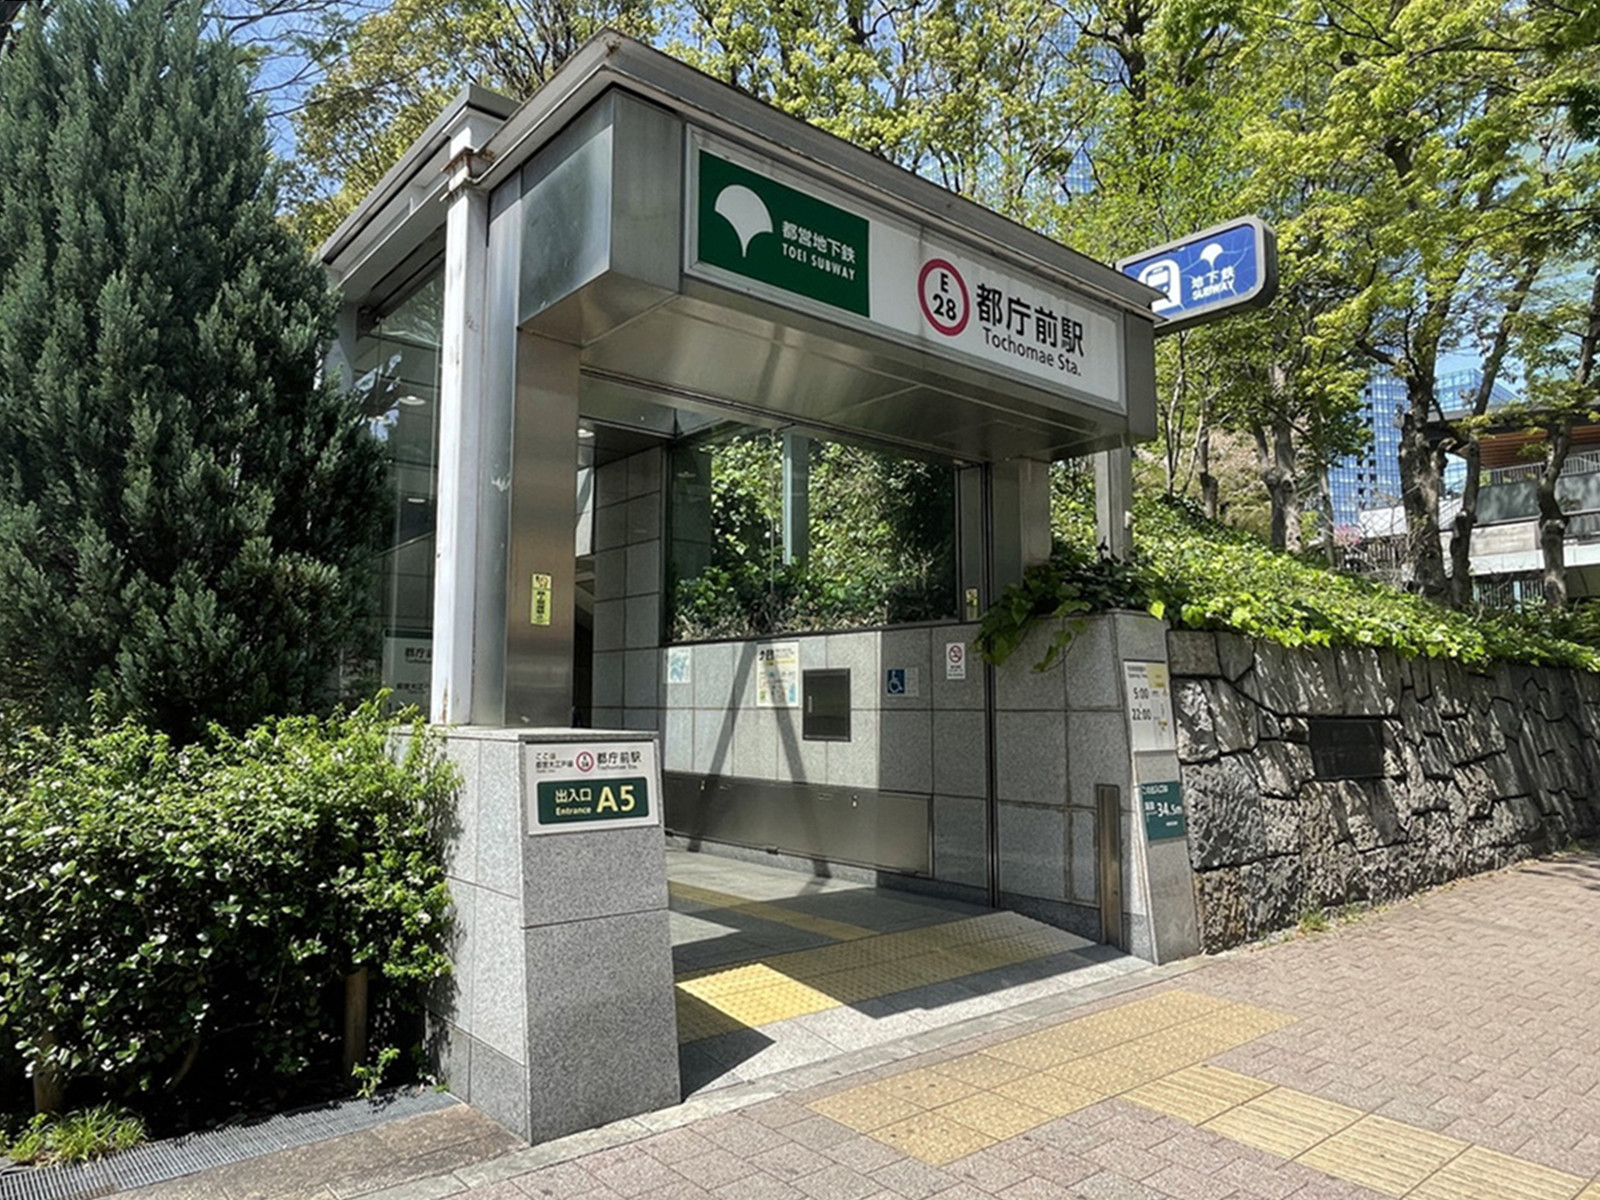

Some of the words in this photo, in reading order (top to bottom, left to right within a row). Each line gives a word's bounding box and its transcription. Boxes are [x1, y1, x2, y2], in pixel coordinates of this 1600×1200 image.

[782, 221, 855, 264] 都営地下鉄
[782, 242, 807, 263] TOEI
[811, 254, 855, 280] SUBWAY
[940, 272, 949, 293] E
[1191, 265, 1235, 289] 地下鉄
[1192, 280, 1235, 301] SUBWAY
[933, 293, 957, 321] 28
[976, 283, 1084, 357] 都庁前駅
[982, 326, 1054, 367] Tochomae
[1058, 353, 1082, 377] Sta.
[597, 751, 642, 764] 都庁前駅
[555, 788, 592, 803] 出入口
[596, 785, 636, 814] A5
[555, 806, 592, 817] Entrance
